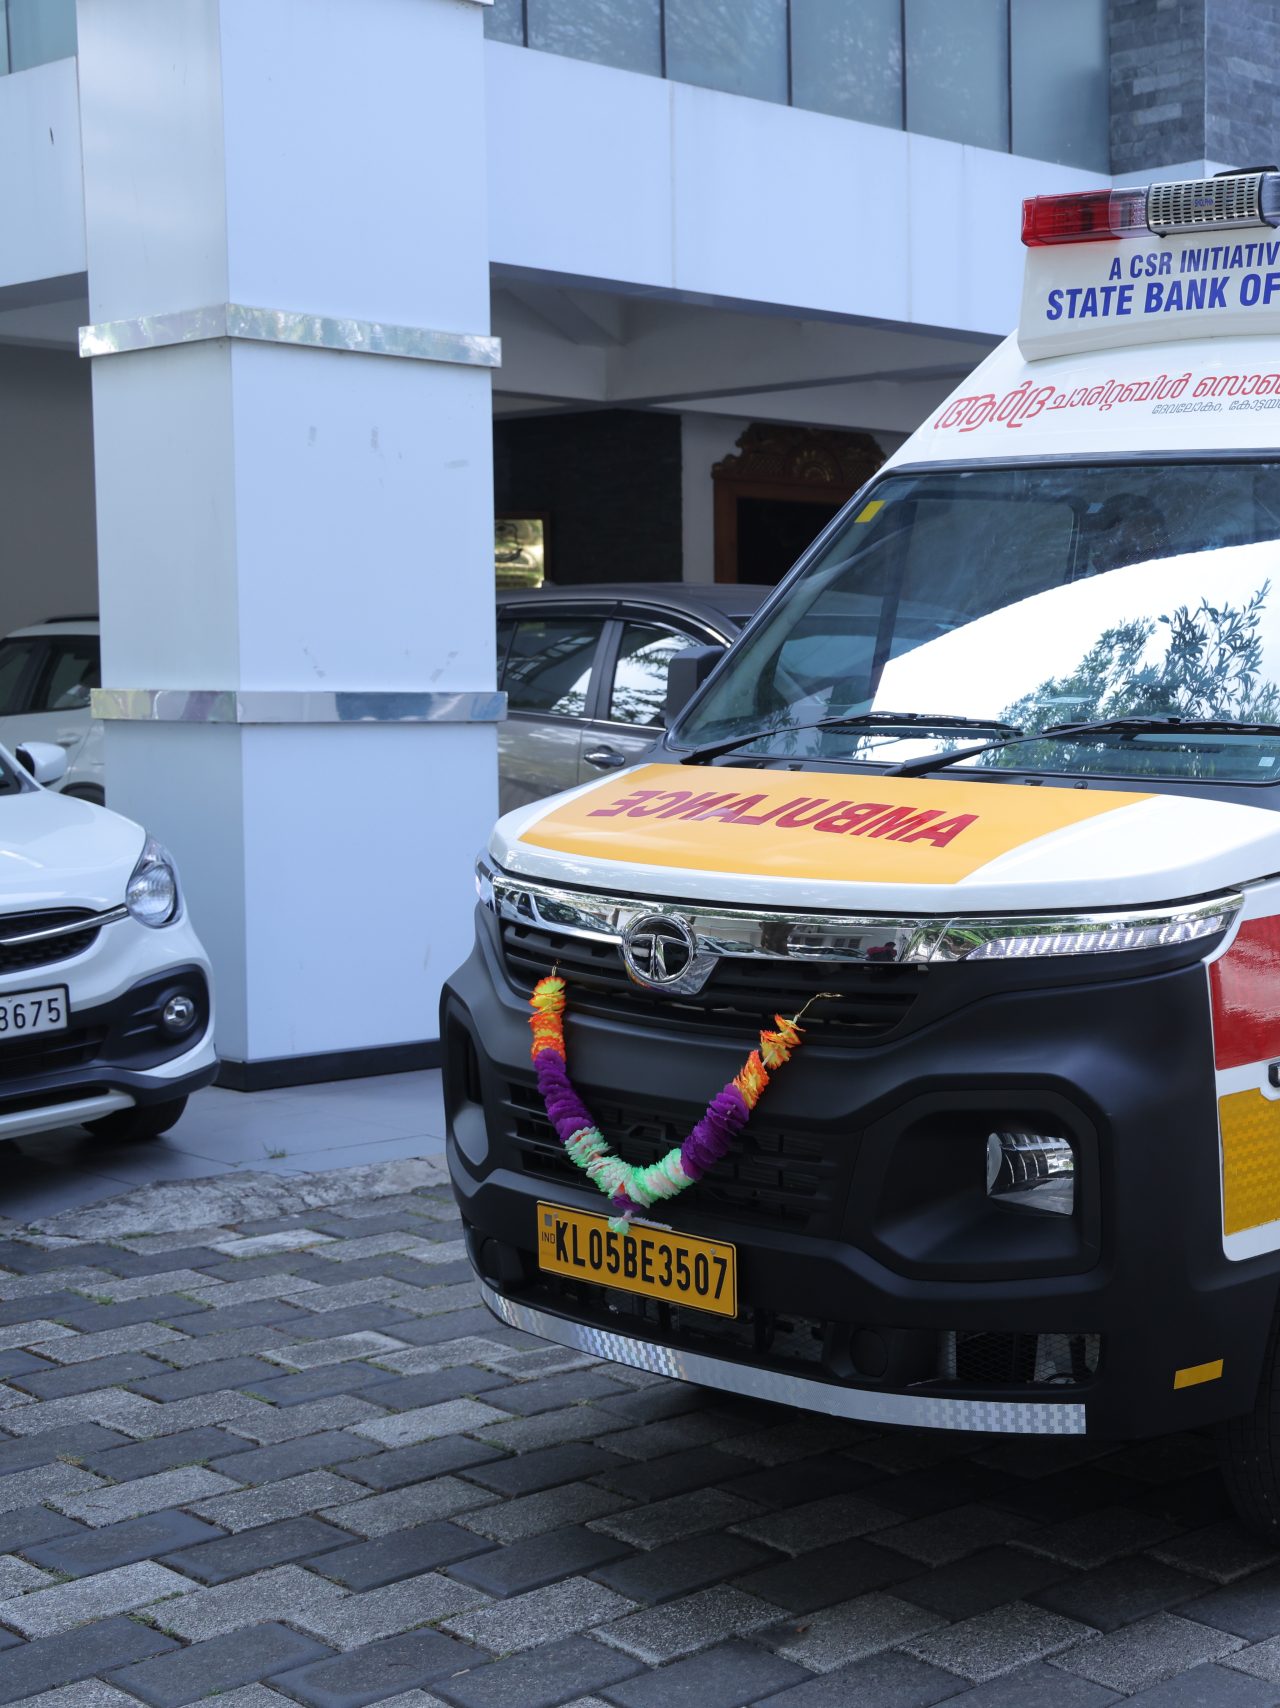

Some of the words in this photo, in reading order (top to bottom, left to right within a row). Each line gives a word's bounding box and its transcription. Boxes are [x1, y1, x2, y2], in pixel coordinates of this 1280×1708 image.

[1108, 257, 1122, 281] A
[1129, 251, 1173, 279] CSR
[1046, 284, 1135, 320] STATE
[1144, 275, 1231, 314] BANK
[933, 380, 1056, 433] ആർദ്ര
[541, 1231, 556, 1245] IND
[555, 1220, 728, 1300] KL05BE3507
